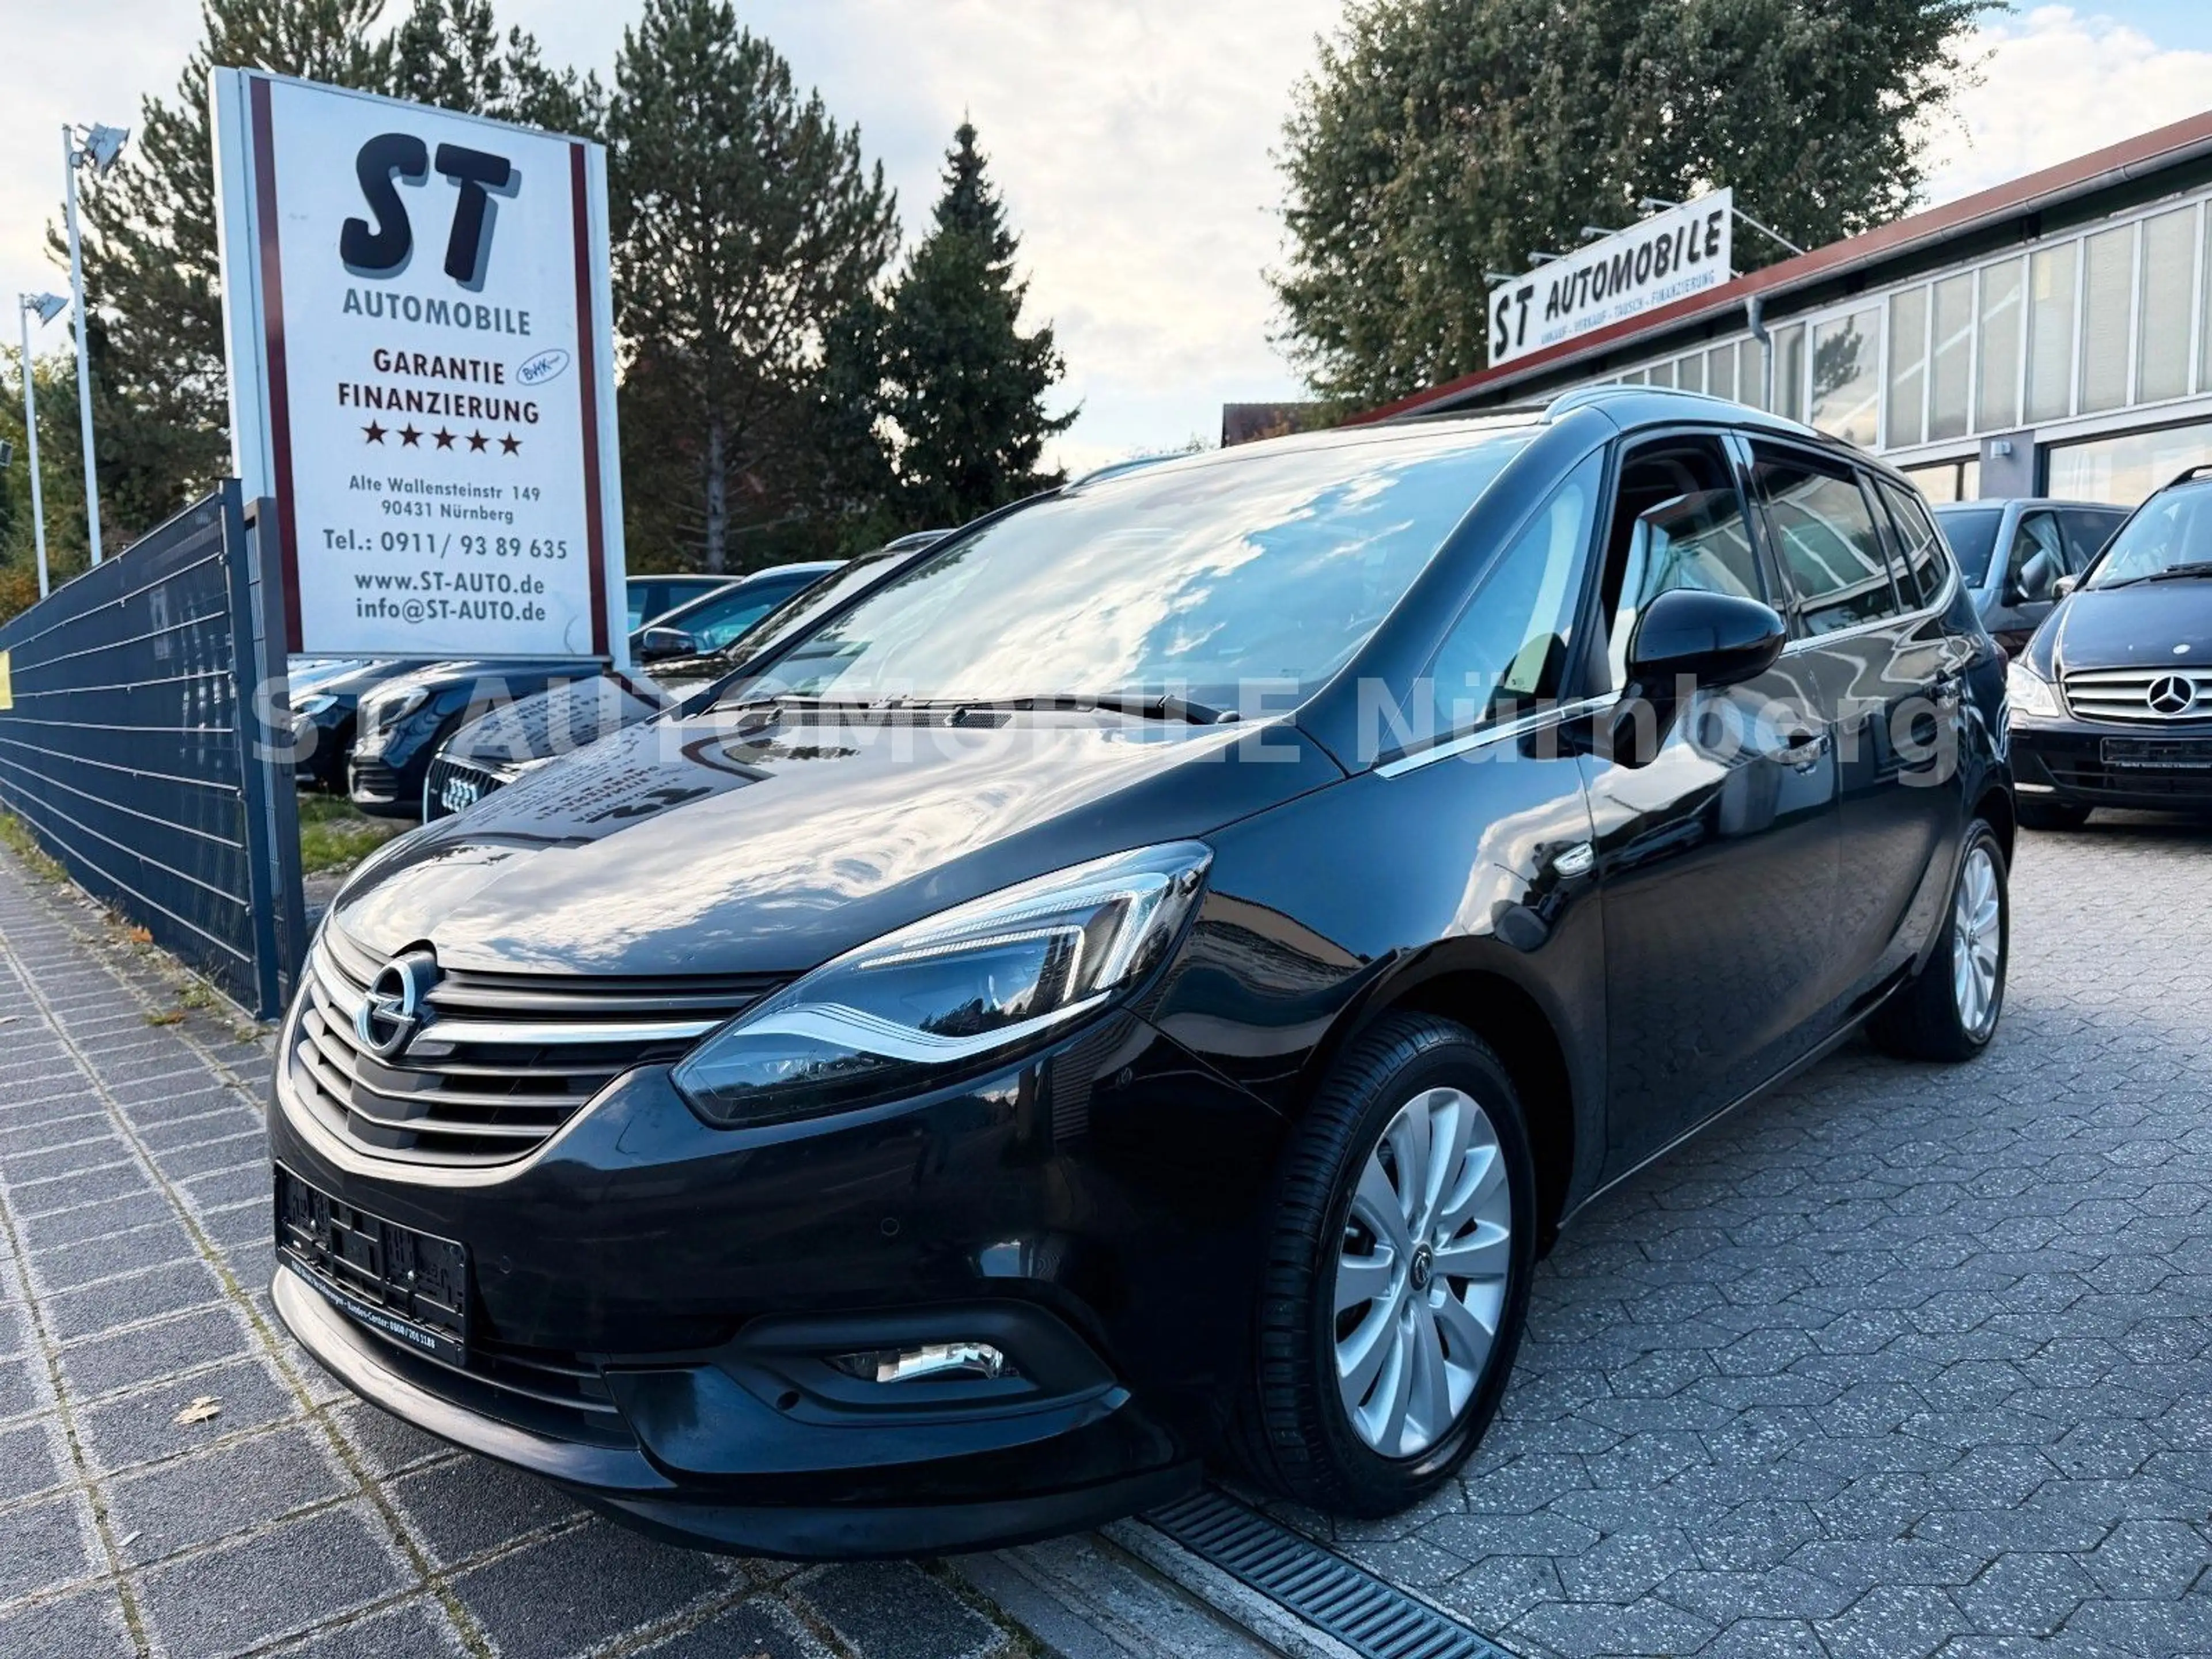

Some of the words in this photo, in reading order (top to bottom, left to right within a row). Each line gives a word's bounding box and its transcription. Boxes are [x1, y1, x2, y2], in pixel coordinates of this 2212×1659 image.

[339, 132, 521, 292] ST
[1494, 285, 1533, 358] ST
[1546, 209, 1724, 322] AUTOMOBILE
[343, 289, 531, 336] AUTOMOBILE
[373, 349, 505, 385] GARANTIE
[339, 382, 539, 423] FINANZIERUNG
[349, 475, 382, 491] Alte
[388, 478, 503, 499] Wallensteinstr
[513, 486, 541, 502] 149
[381, 499, 433, 517] 90431
[440, 503, 514, 525] Nürnberg
[323, 529, 372, 551] Tel.:
[460, 535, 487, 555] 93
[496, 537, 521, 557] 89
[530, 539, 568, 559] 635
[354, 570, 544, 594] www.ST-AUTO.de
[356, 597, 546, 623] info@ST-AUTO.de
